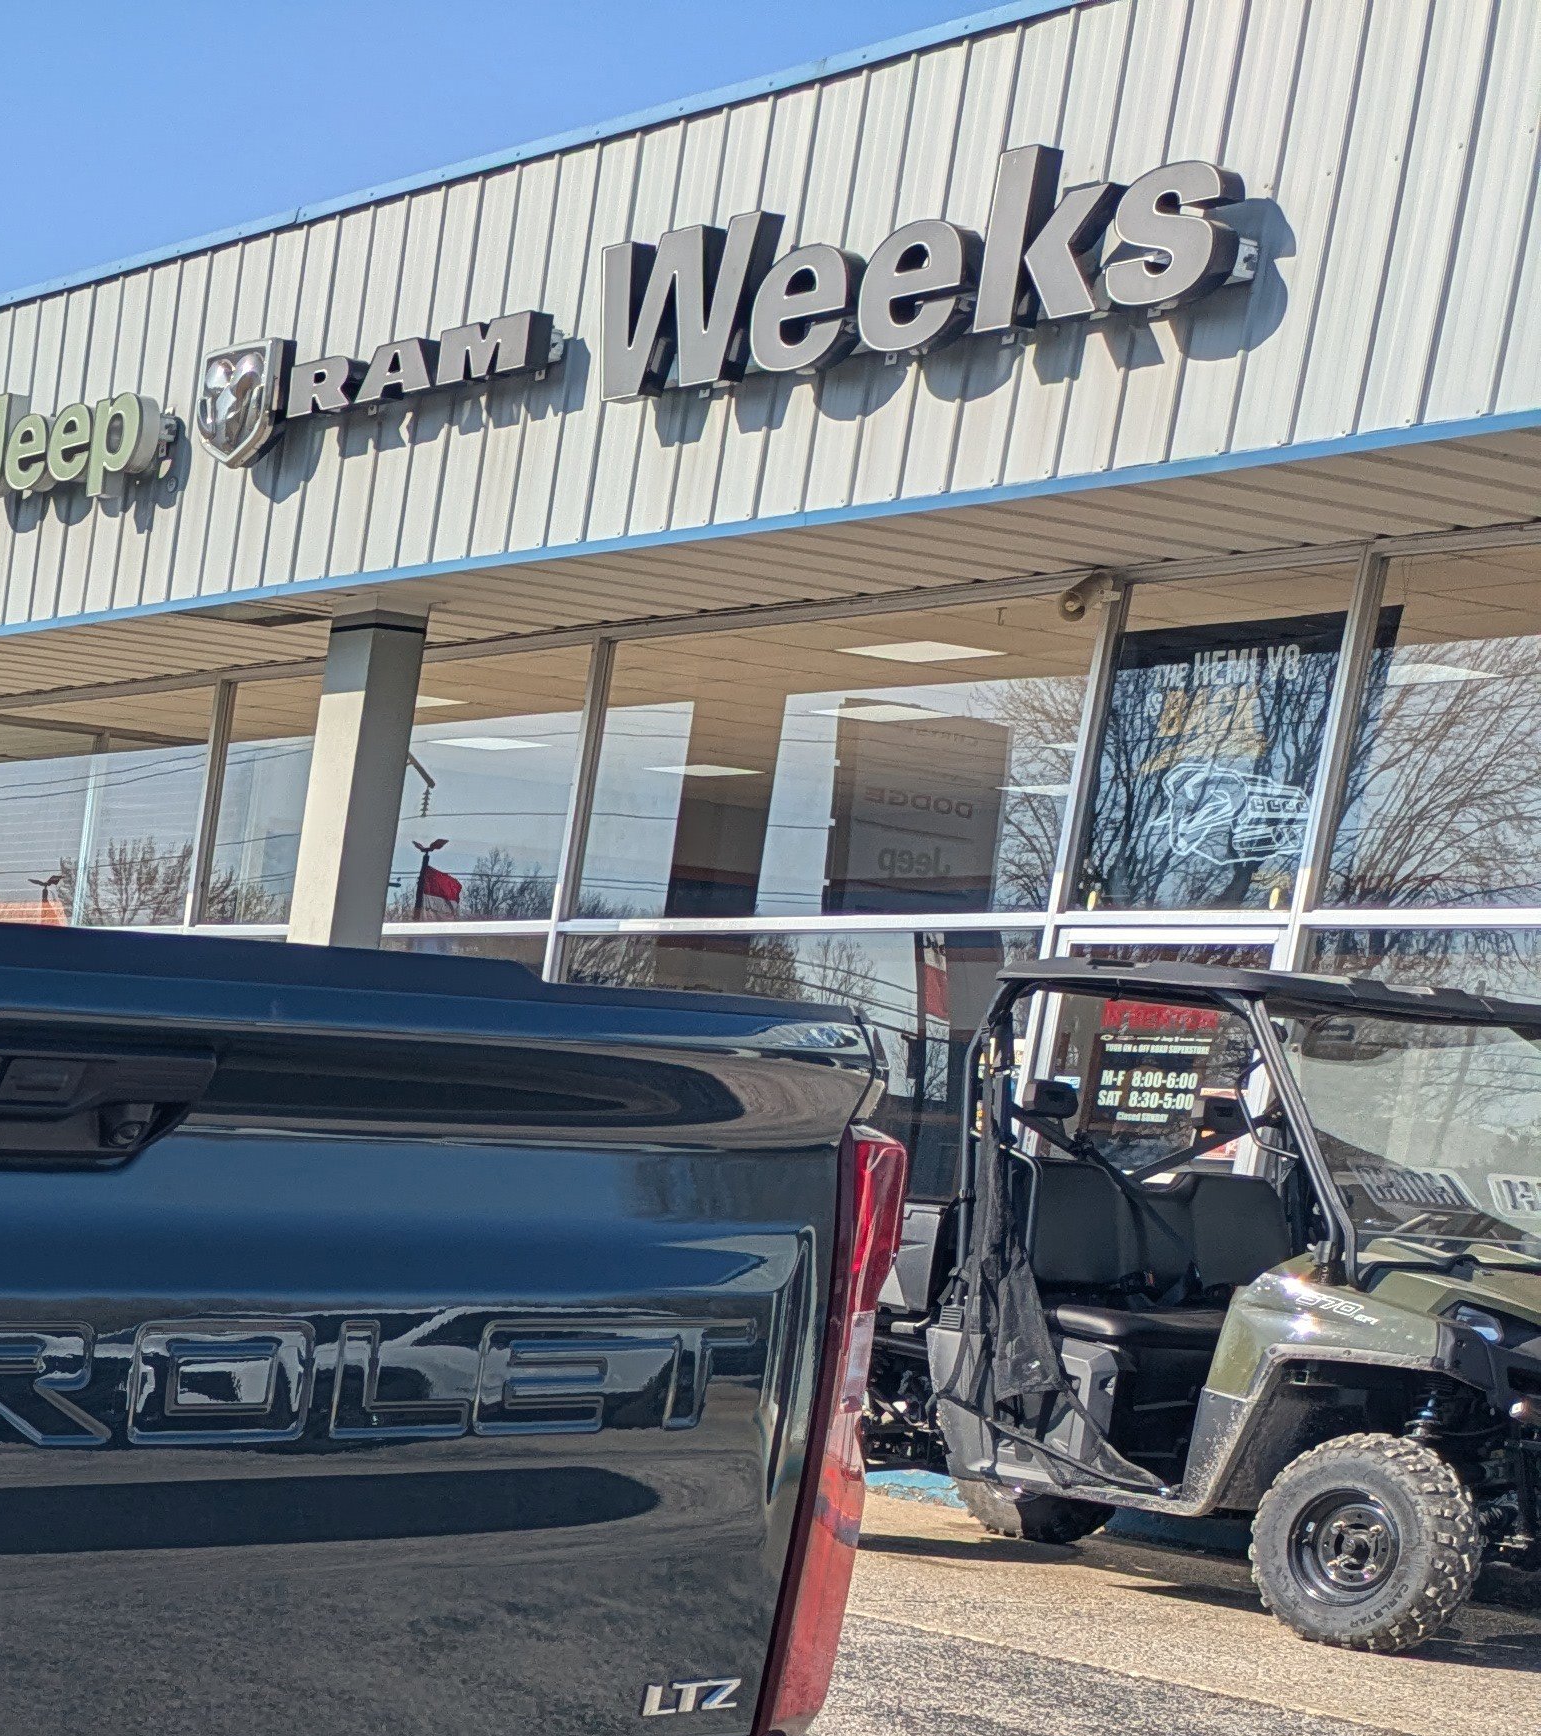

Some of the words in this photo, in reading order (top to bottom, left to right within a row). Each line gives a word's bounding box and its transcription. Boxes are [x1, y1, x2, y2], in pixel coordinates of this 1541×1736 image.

[600, 144, 1251, 402] Weeks
[287, 310, 539, 419] RAM
[1192, 647, 1262, 687] HEMI
[1266, 643, 1301, 681] V8
[1157, 682, 1264, 738] BACK
[1097, 1090, 1123, 1107] SAT
[1128, 1091, 1195, 1111] 8:30-5:00
[1101, 1070, 1126, 1087] M-F
[1131, 1071, 1199, 1090] 8:00-6:00
[642, 1678, 742, 1717] LTZ
